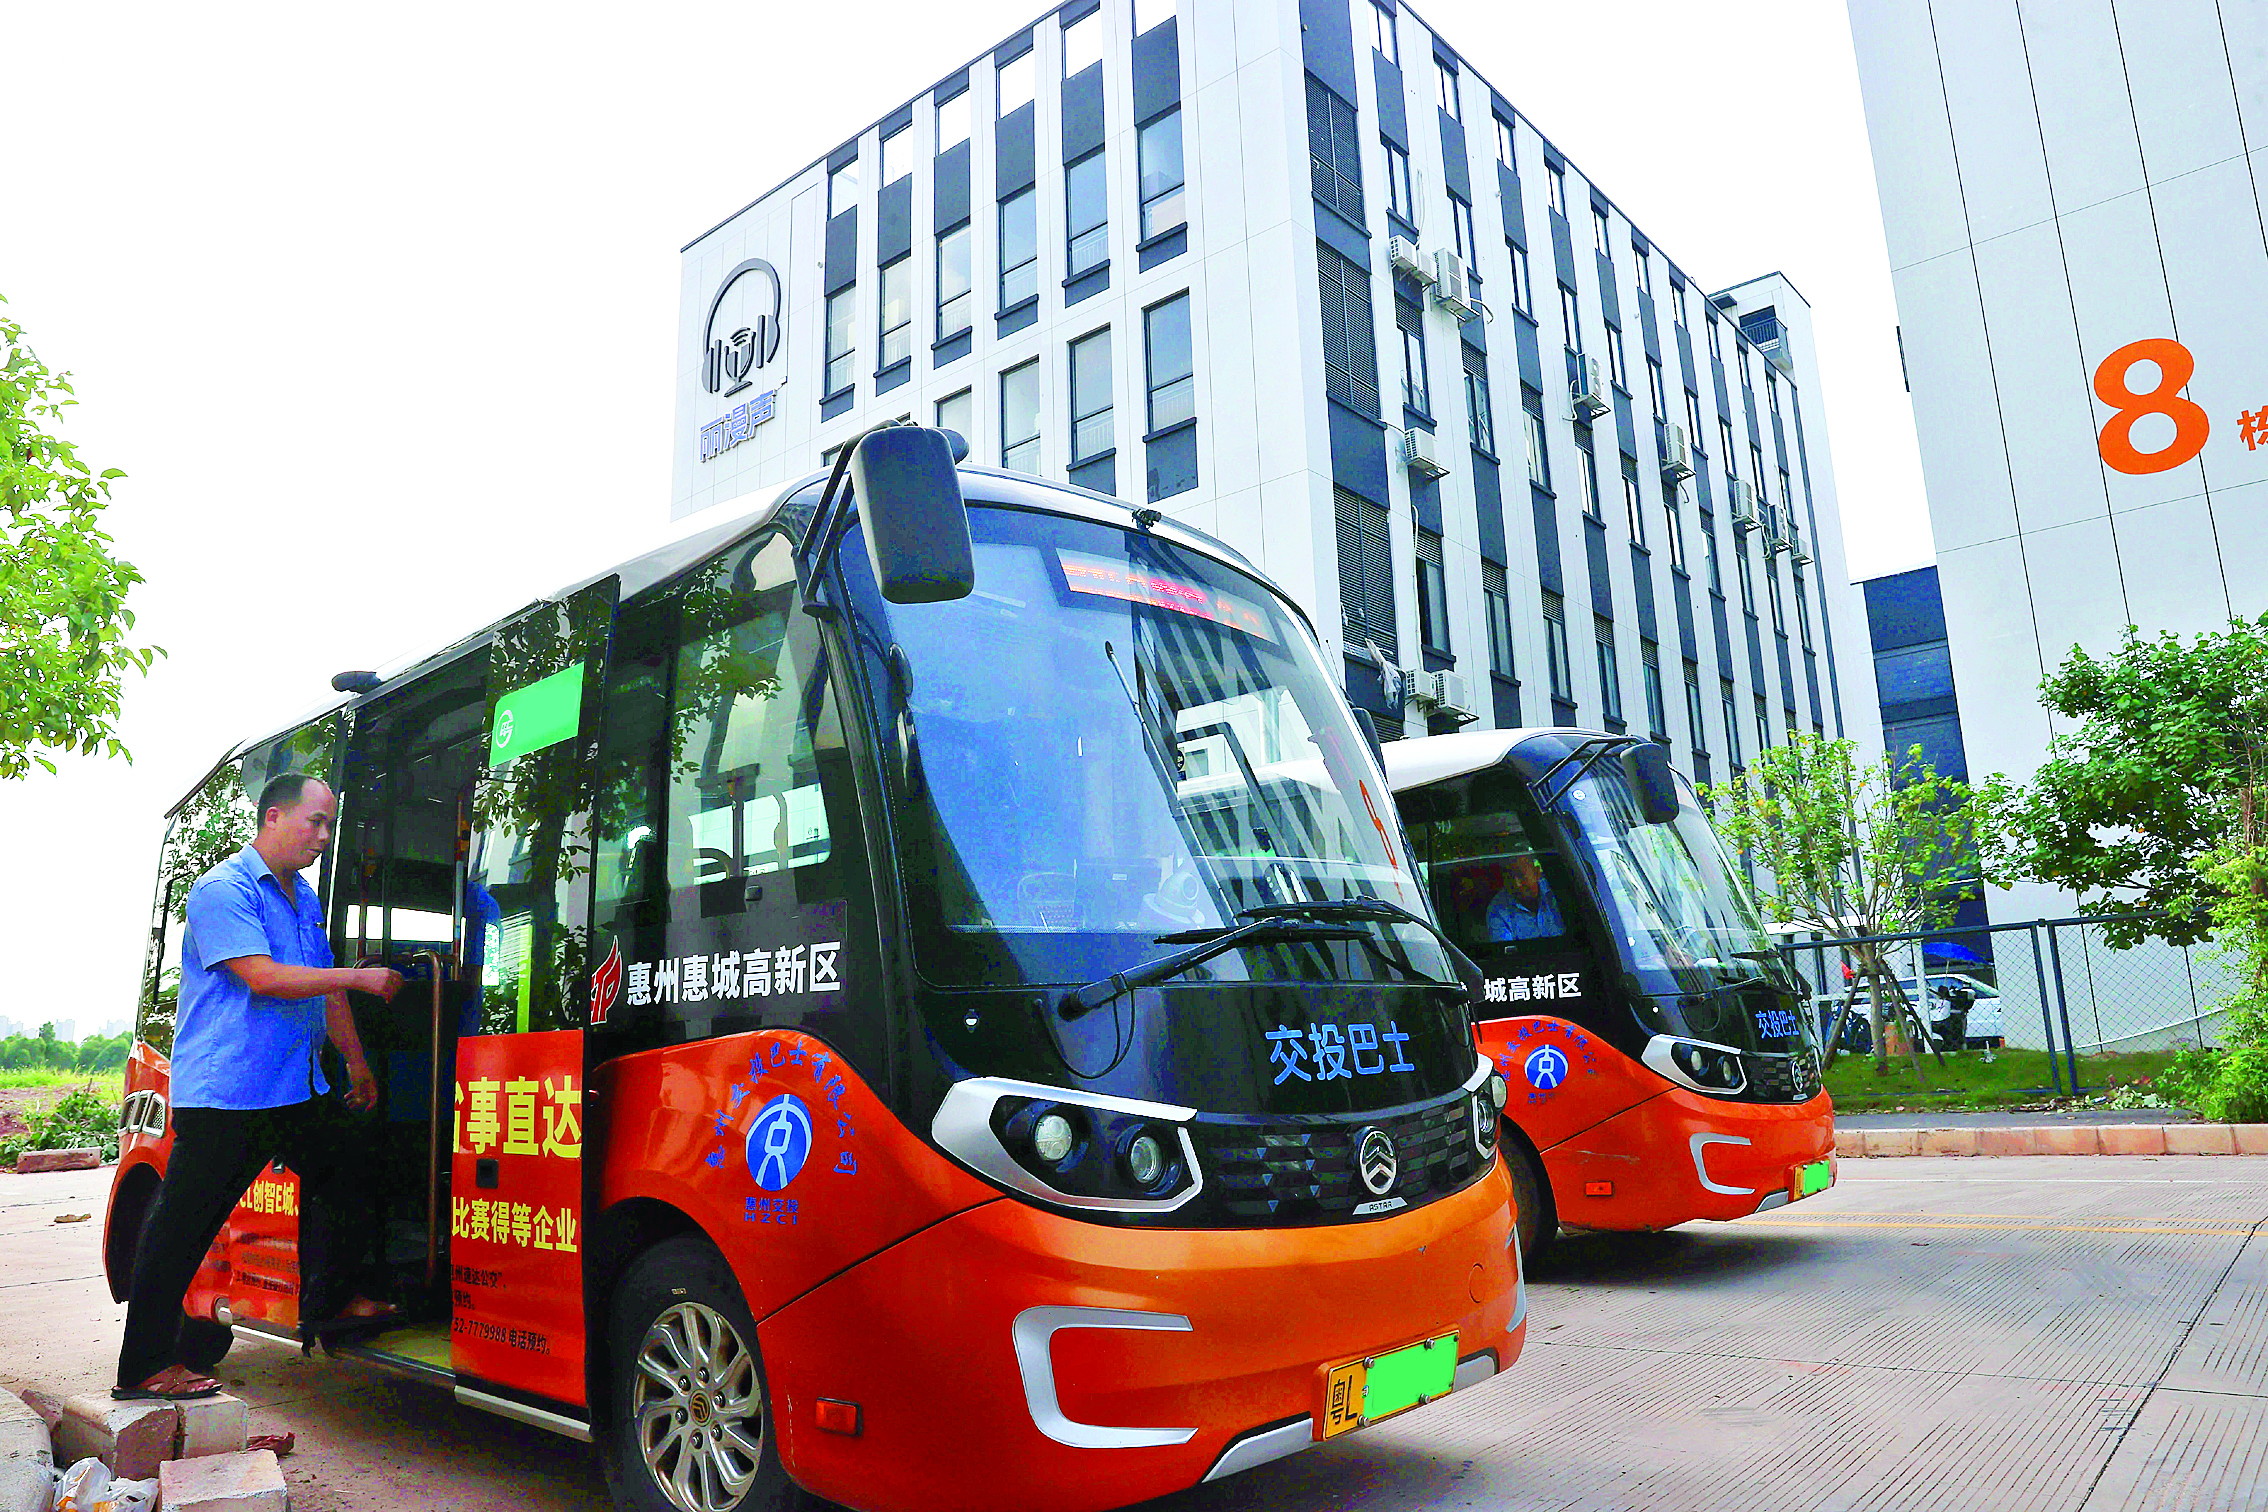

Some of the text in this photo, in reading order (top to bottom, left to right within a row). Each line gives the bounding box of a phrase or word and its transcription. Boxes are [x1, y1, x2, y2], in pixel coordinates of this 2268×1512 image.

[2093, 337, 2210, 475] 8
[626, 941, 841, 1007] 惠州惠城高新区
[1483, 972, 1582, 1003] 城高新区
[1755, 1009, 1800, 1039] 交投巴士
[1265, 1020, 1415, 1086] 交投巴士
[452, 1196, 577, 1253] 比赛得等企业
[745, 1197, 798, 1213] 惠州交投
[1330, 1374, 1358, 1425] 粤L
